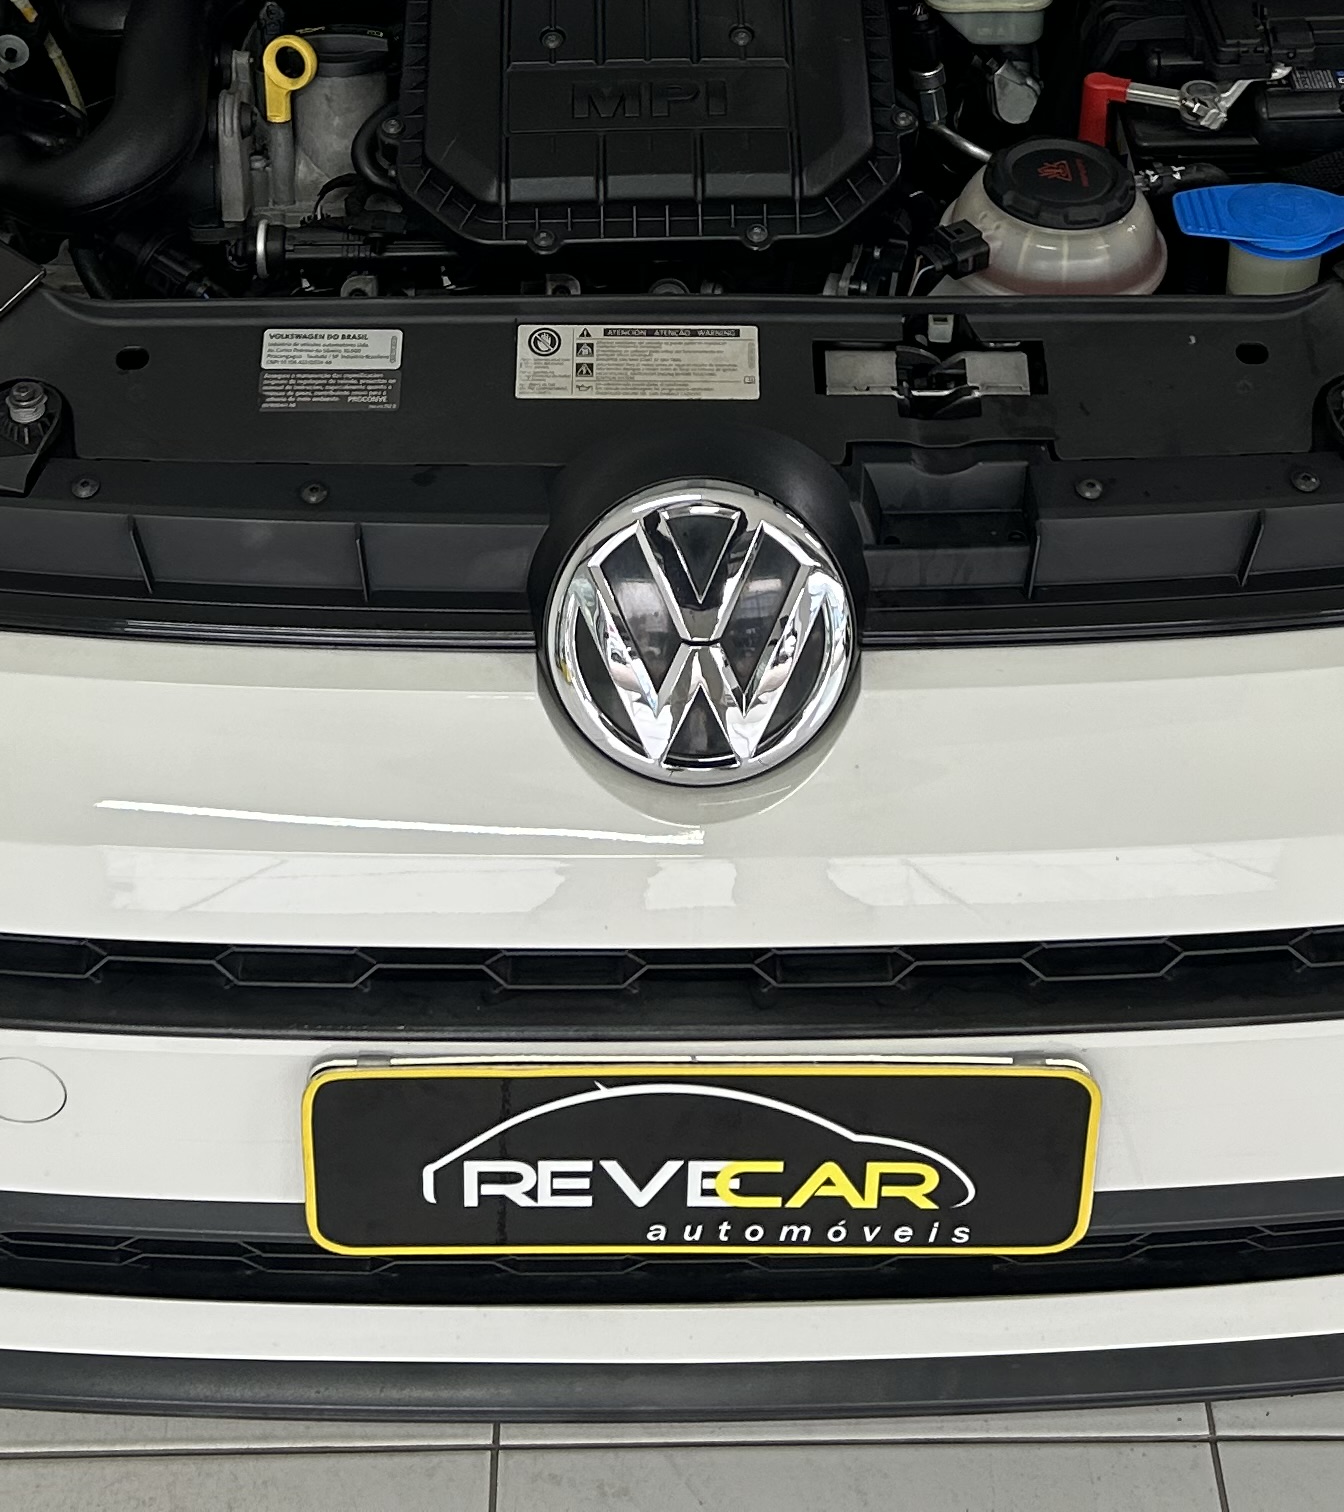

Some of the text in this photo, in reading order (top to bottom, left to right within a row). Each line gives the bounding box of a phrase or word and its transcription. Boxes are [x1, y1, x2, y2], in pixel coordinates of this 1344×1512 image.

[570, 79, 728, 120] MPI
[340, 333, 369, 341] BRASIL
[463, 1159, 940, 1210] REVECAR
[646, 1219, 972, 1244] automóveis
